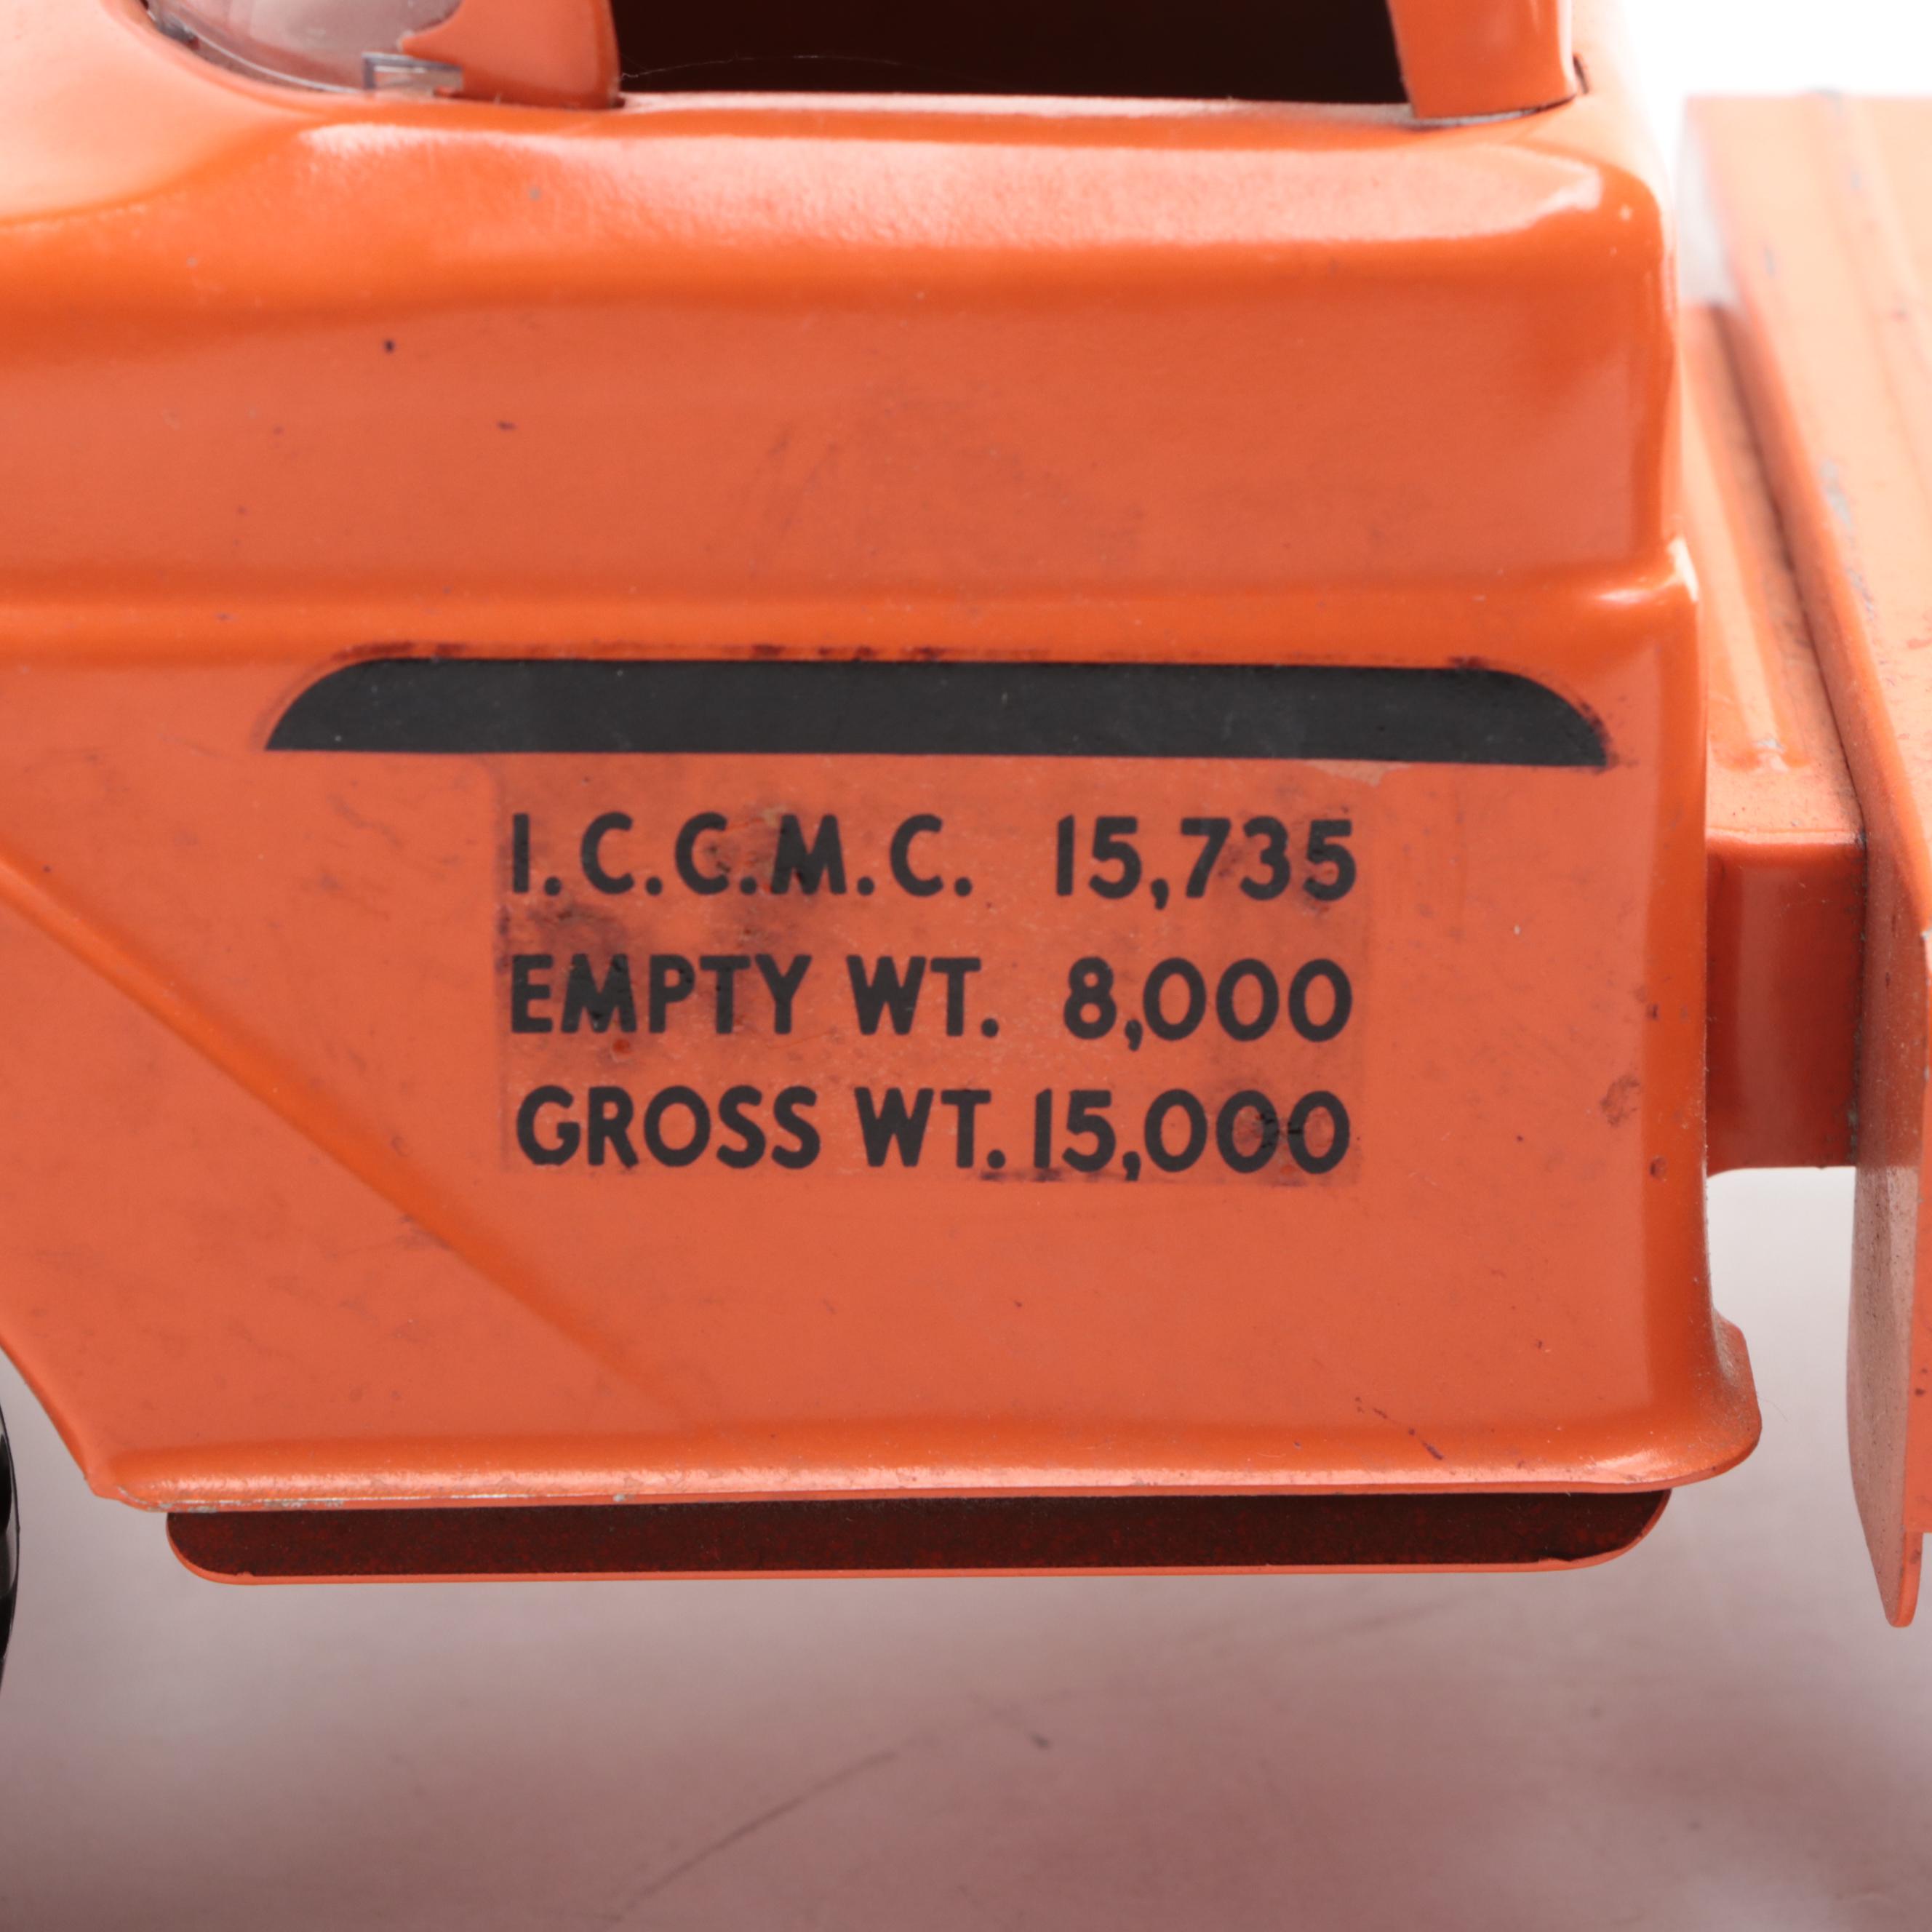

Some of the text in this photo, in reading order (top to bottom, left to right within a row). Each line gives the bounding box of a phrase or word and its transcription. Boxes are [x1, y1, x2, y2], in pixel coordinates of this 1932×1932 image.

[1056, 815, 1357, 909] 15,735
[511, 952, 1353, 1052] EMPTY WT. 8,000
[516, 1085, 1352, 1182] GROSS WT. 15,000
